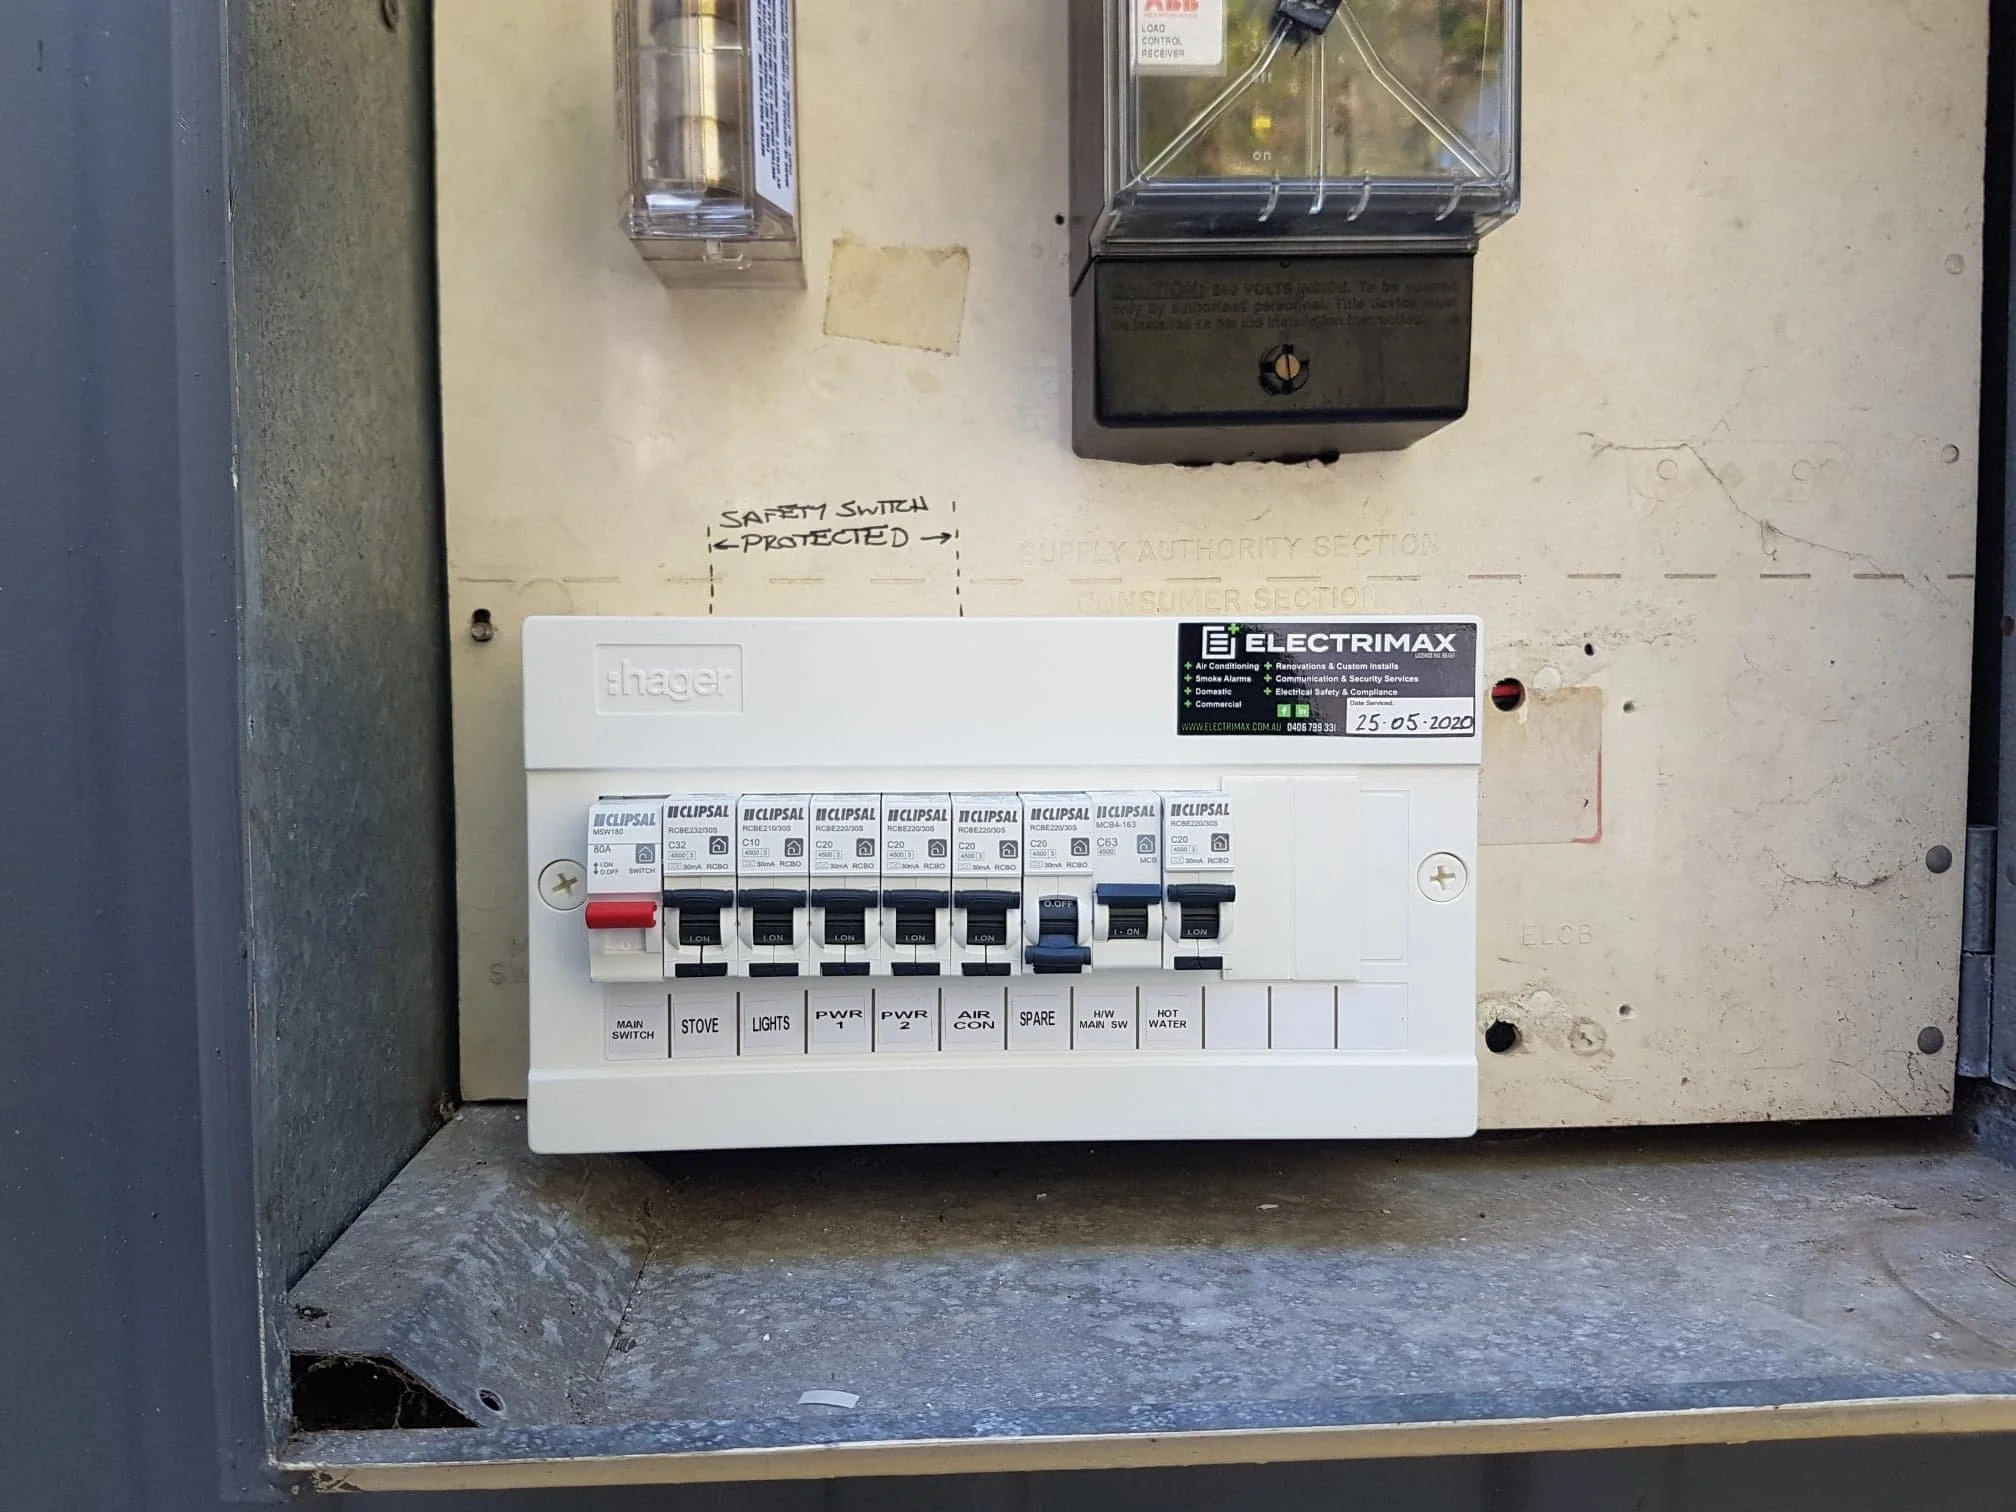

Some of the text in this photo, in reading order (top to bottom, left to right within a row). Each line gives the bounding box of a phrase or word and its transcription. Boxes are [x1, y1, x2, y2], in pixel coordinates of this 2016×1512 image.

[1142, 24, 1166, 33] LOAD
[1142, 37, 1183, 46] CONTROL
[1142, 49, 1184, 58] RECEIVER
[1252, 151, 1272, 161] on
[719, 496, 929, 528] SAFETY SWITCH
[741, 524, 909, 553] PROTECTED
[1020, 533, 1440, 564] SUPPLY AUTHORITY SECTION
[1078, 586, 1378, 614] CONSUMER SECTION
[1245, 633, 1457, 653] ELECTRIMAX
[1195, 662, 1259, 671] Air Conditioning
[1275, 662, 1326, 670] Renovations
[1336, 662, 1368, 670] Custom
[1369, 662, 1399, 670] Installs
[1195, 675, 1252, 683] Smoke Alarms
[1275, 675, 1419, 684] Communication & Security Services
[1195, 687, 1232, 696] Domestic
[1275, 688, 1398, 697] Electrical Safety & Compliance
[1195, 700, 1242, 708] Commercial
[1181, 722, 1281, 732] WWW.ELECTRIMAX.COM.AU
[1287, 722, 1307, 732] 0406
[1030, 824, 1078, 832] RCBE220/30S
[1096, 821, 1136, 829] MCB4-163
[742, 839, 760, 847] C10
[1030, 840, 1048, 848] C20
[1097, 838, 1118, 847] C63
[1171, 835, 1188, 844] C20
[668, 841, 687, 850] C32
[815, 840, 833, 849] C20
[887, 840, 905, 849] C20
[958, 842, 976, 850] C20
[593, 845, 612, 854] 80A
[815, 1009, 863, 1020] PWR
[881, 1010, 928, 1020] PWR
[958, 1010, 991, 1019] AIR
[1094, 1009, 1115, 1018] H/W
[1157, 1009, 1179, 1018] HOT
[752, 1015, 790, 1032] LIGHTS
[1019, 1011, 1056, 1027] SPARE
[616, 1020, 643, 1029] MAIN
[681, 1017, 719, 1034] STOVE
[835, 1021, 844, 1029] 1
[899, 1021, 911, 1030] 2
[953, 1021, 995, 1030] CON
[1080, 1020, 1128, 1029] MAIN SW
[1149, 1020, 1187, 1029] WATER
[612, 1031, 654, 1040] SWITCH
